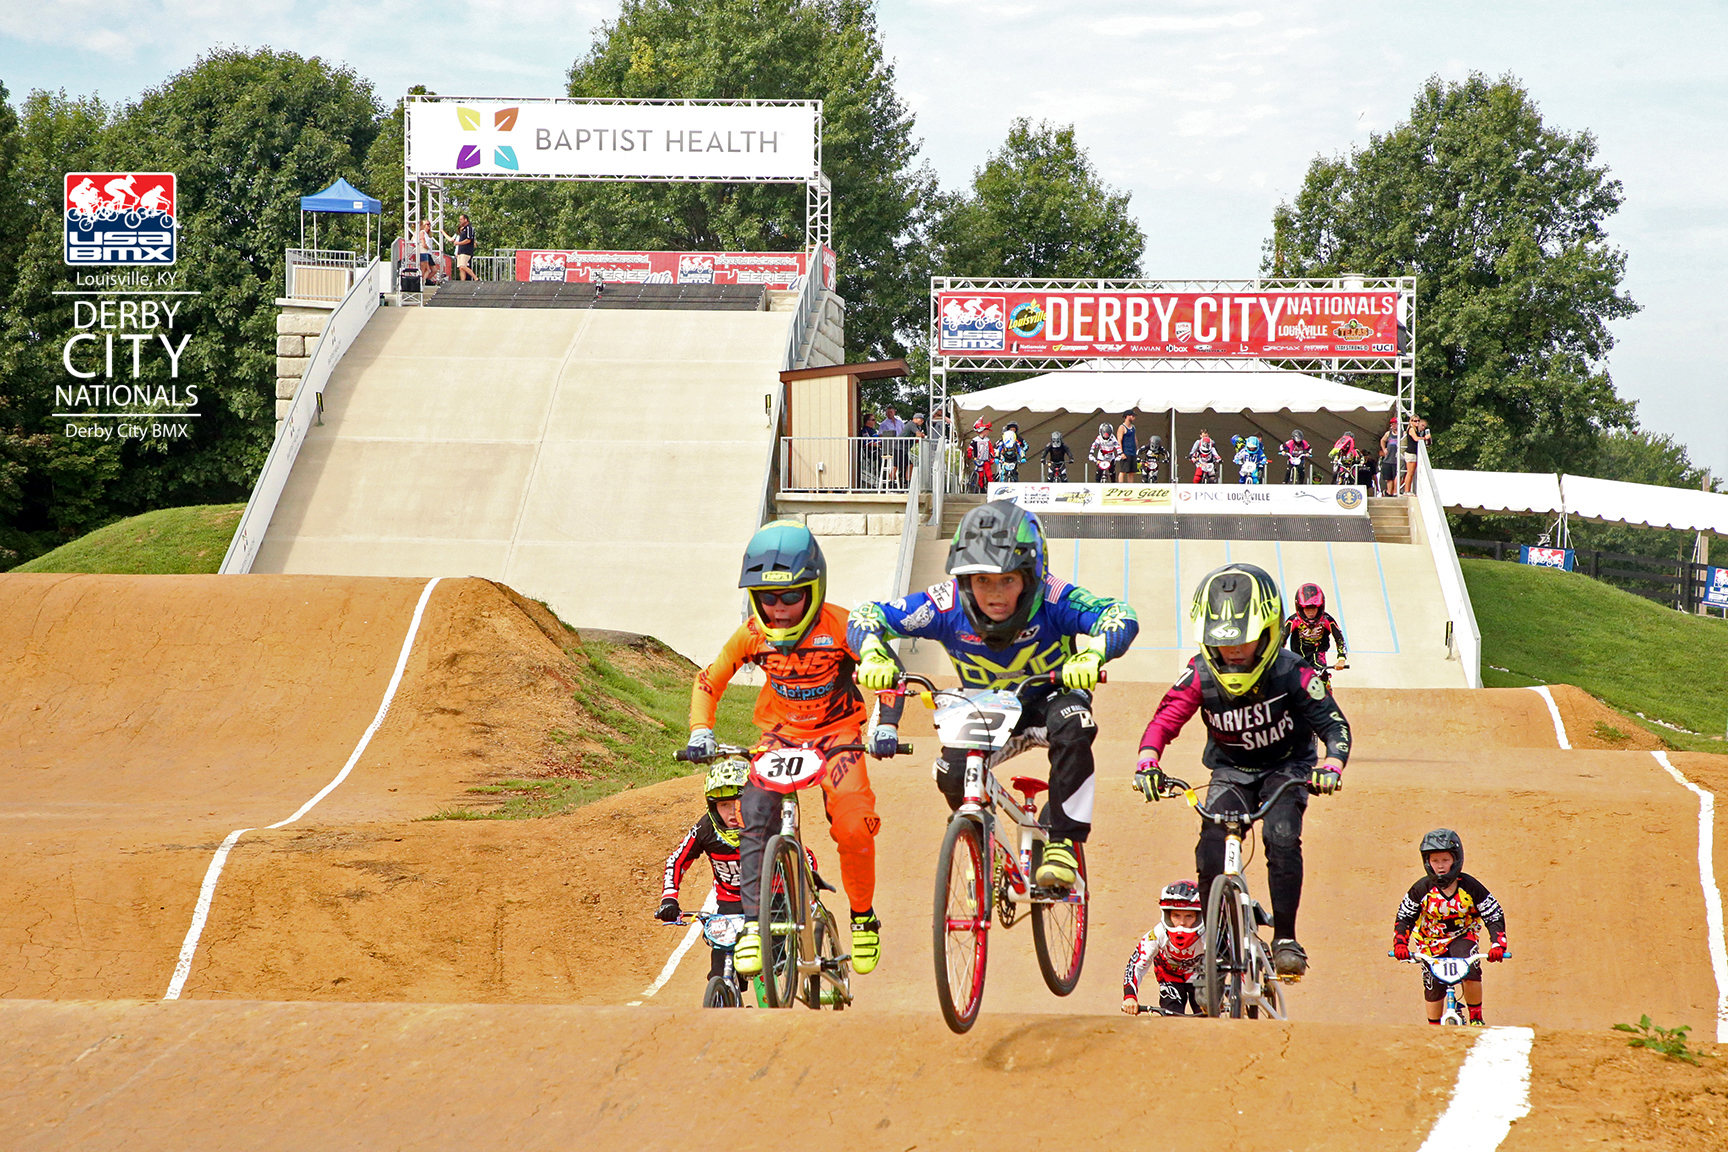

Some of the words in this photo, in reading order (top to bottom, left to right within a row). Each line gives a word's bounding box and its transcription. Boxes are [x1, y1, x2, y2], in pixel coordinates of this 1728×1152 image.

[535, 128, 653, 152] BAPTIST
[666, 129, 779, 154] HEALTH
[1045, 296, 1178, 342] DERBY
[1193, 296, 1286, 343] CITY
[1286, 296, 1394, 316] NATIONALS
[943, 330, 1003, 339] USA
[1278, 324, 1328, 337] LOUIVILLE
[1338, 327, 1369, 337] TEXAS
[943, 339, 1002, 348] BMX
[1376, 344, 1394, 352] UCI
[1105, 487, 1133, 498] Pro
[1138, 487, 1170, 499] Gate
[1194, 491, 1224, 501] PNC
[1227, 492, 1270, 502] LOUIVILLE
[813, 636, 833, 645] 100%
[954, 711, 1007, 744] 2
[1241, 710, 1295, 751] SNAPS
[767, 756, 804, 777] 30
[1442, 962, 1458, 977] 10
